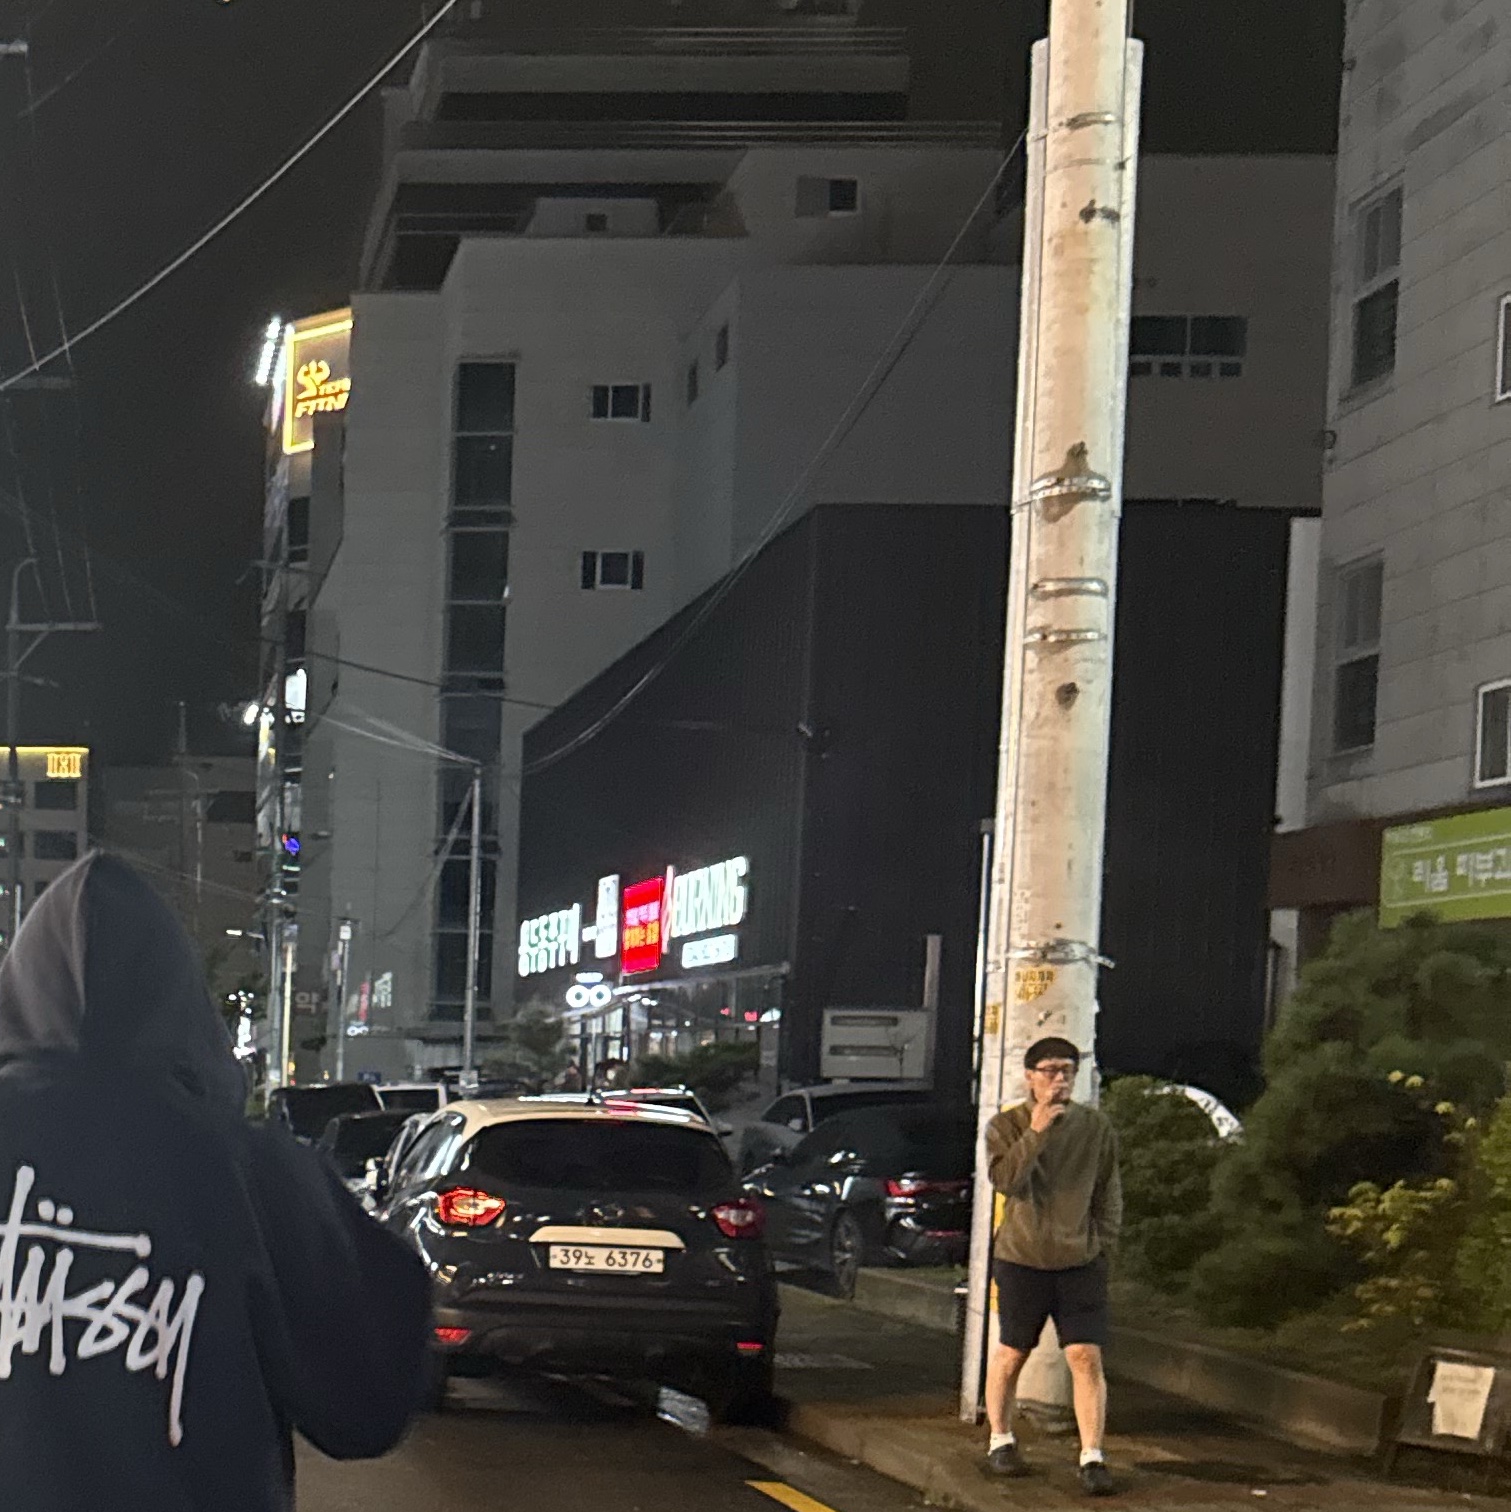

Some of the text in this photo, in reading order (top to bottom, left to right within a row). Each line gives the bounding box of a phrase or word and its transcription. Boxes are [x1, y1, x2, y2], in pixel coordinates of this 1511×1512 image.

[670, 856, 748, 938] BURNING
[559, 1248, 654, 1269] 39노 6376
